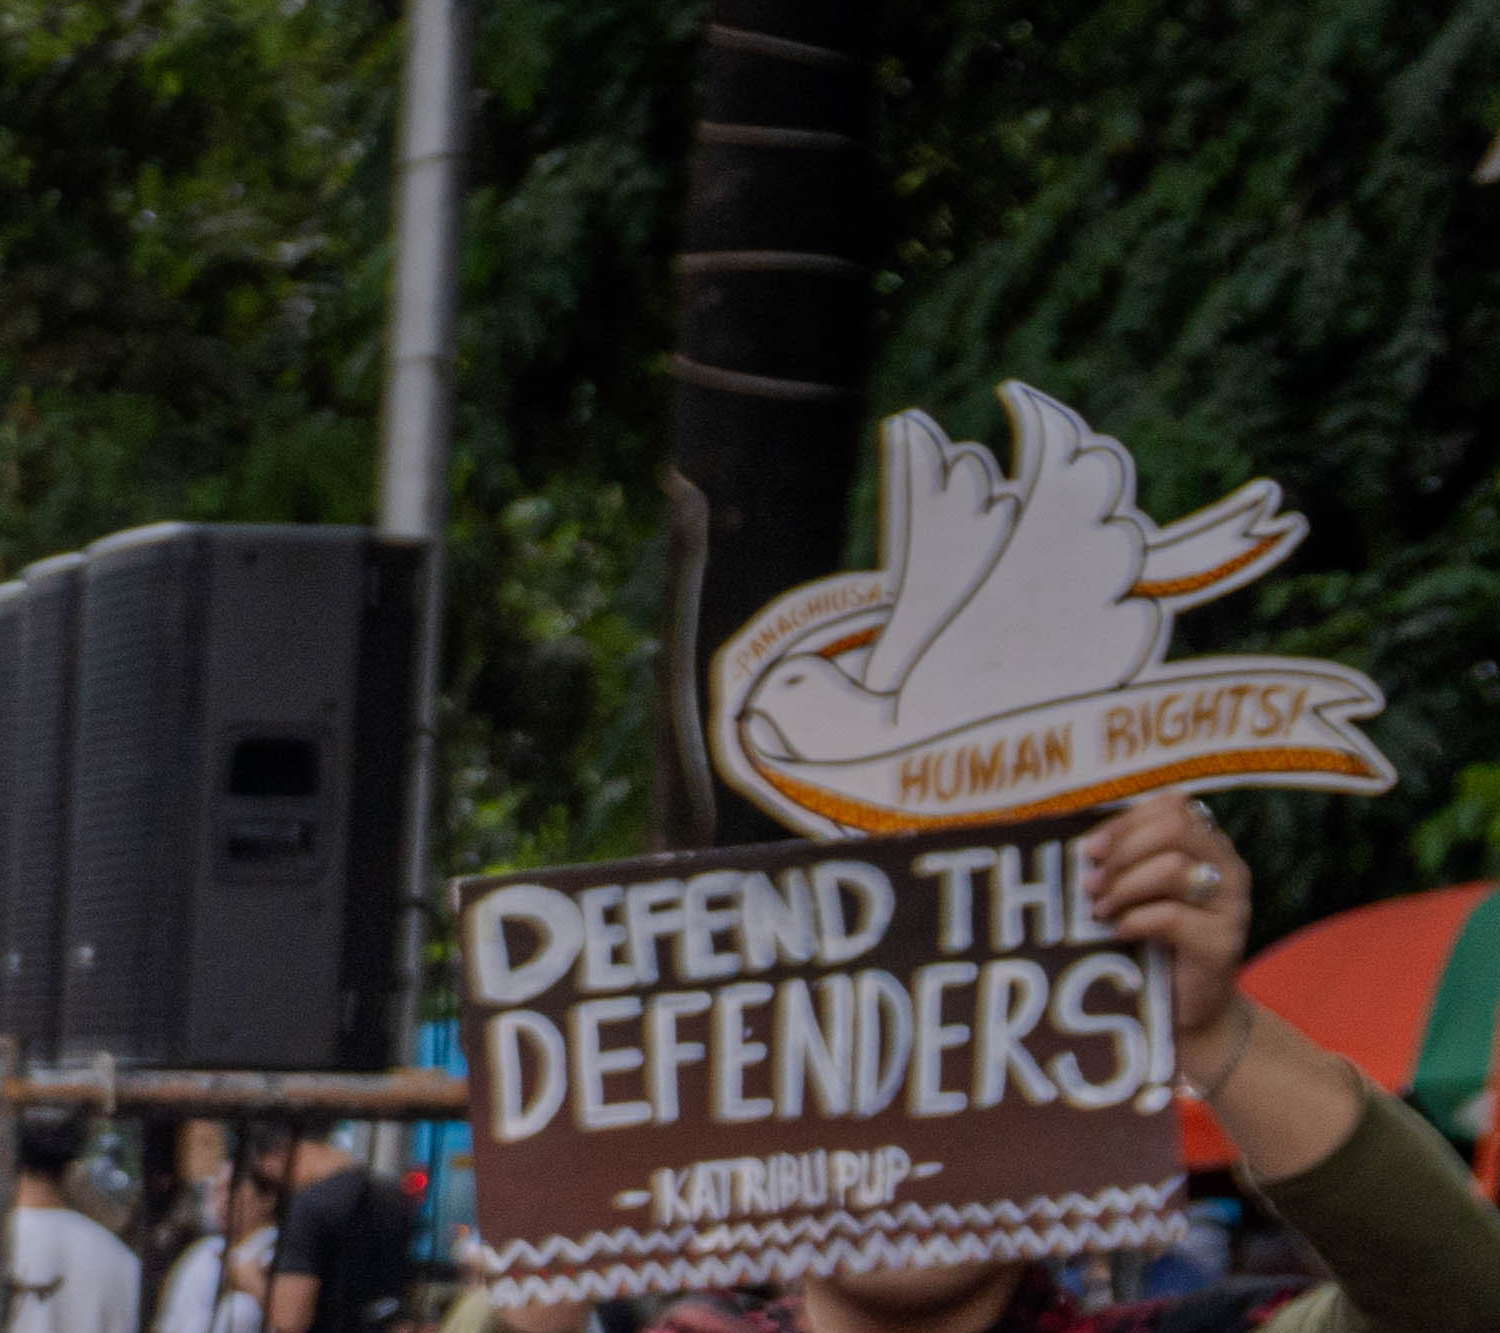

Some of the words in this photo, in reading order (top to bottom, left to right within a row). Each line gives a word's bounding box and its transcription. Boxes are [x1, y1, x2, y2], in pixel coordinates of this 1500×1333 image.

[901, 725, 1074, 802] HUMAN
[1105, 682, 1309, 765] RIGHTS!
[471, 860, 895, 1004] DEFEND
[487, 945, 1177, 1145] DEFENDERS!
